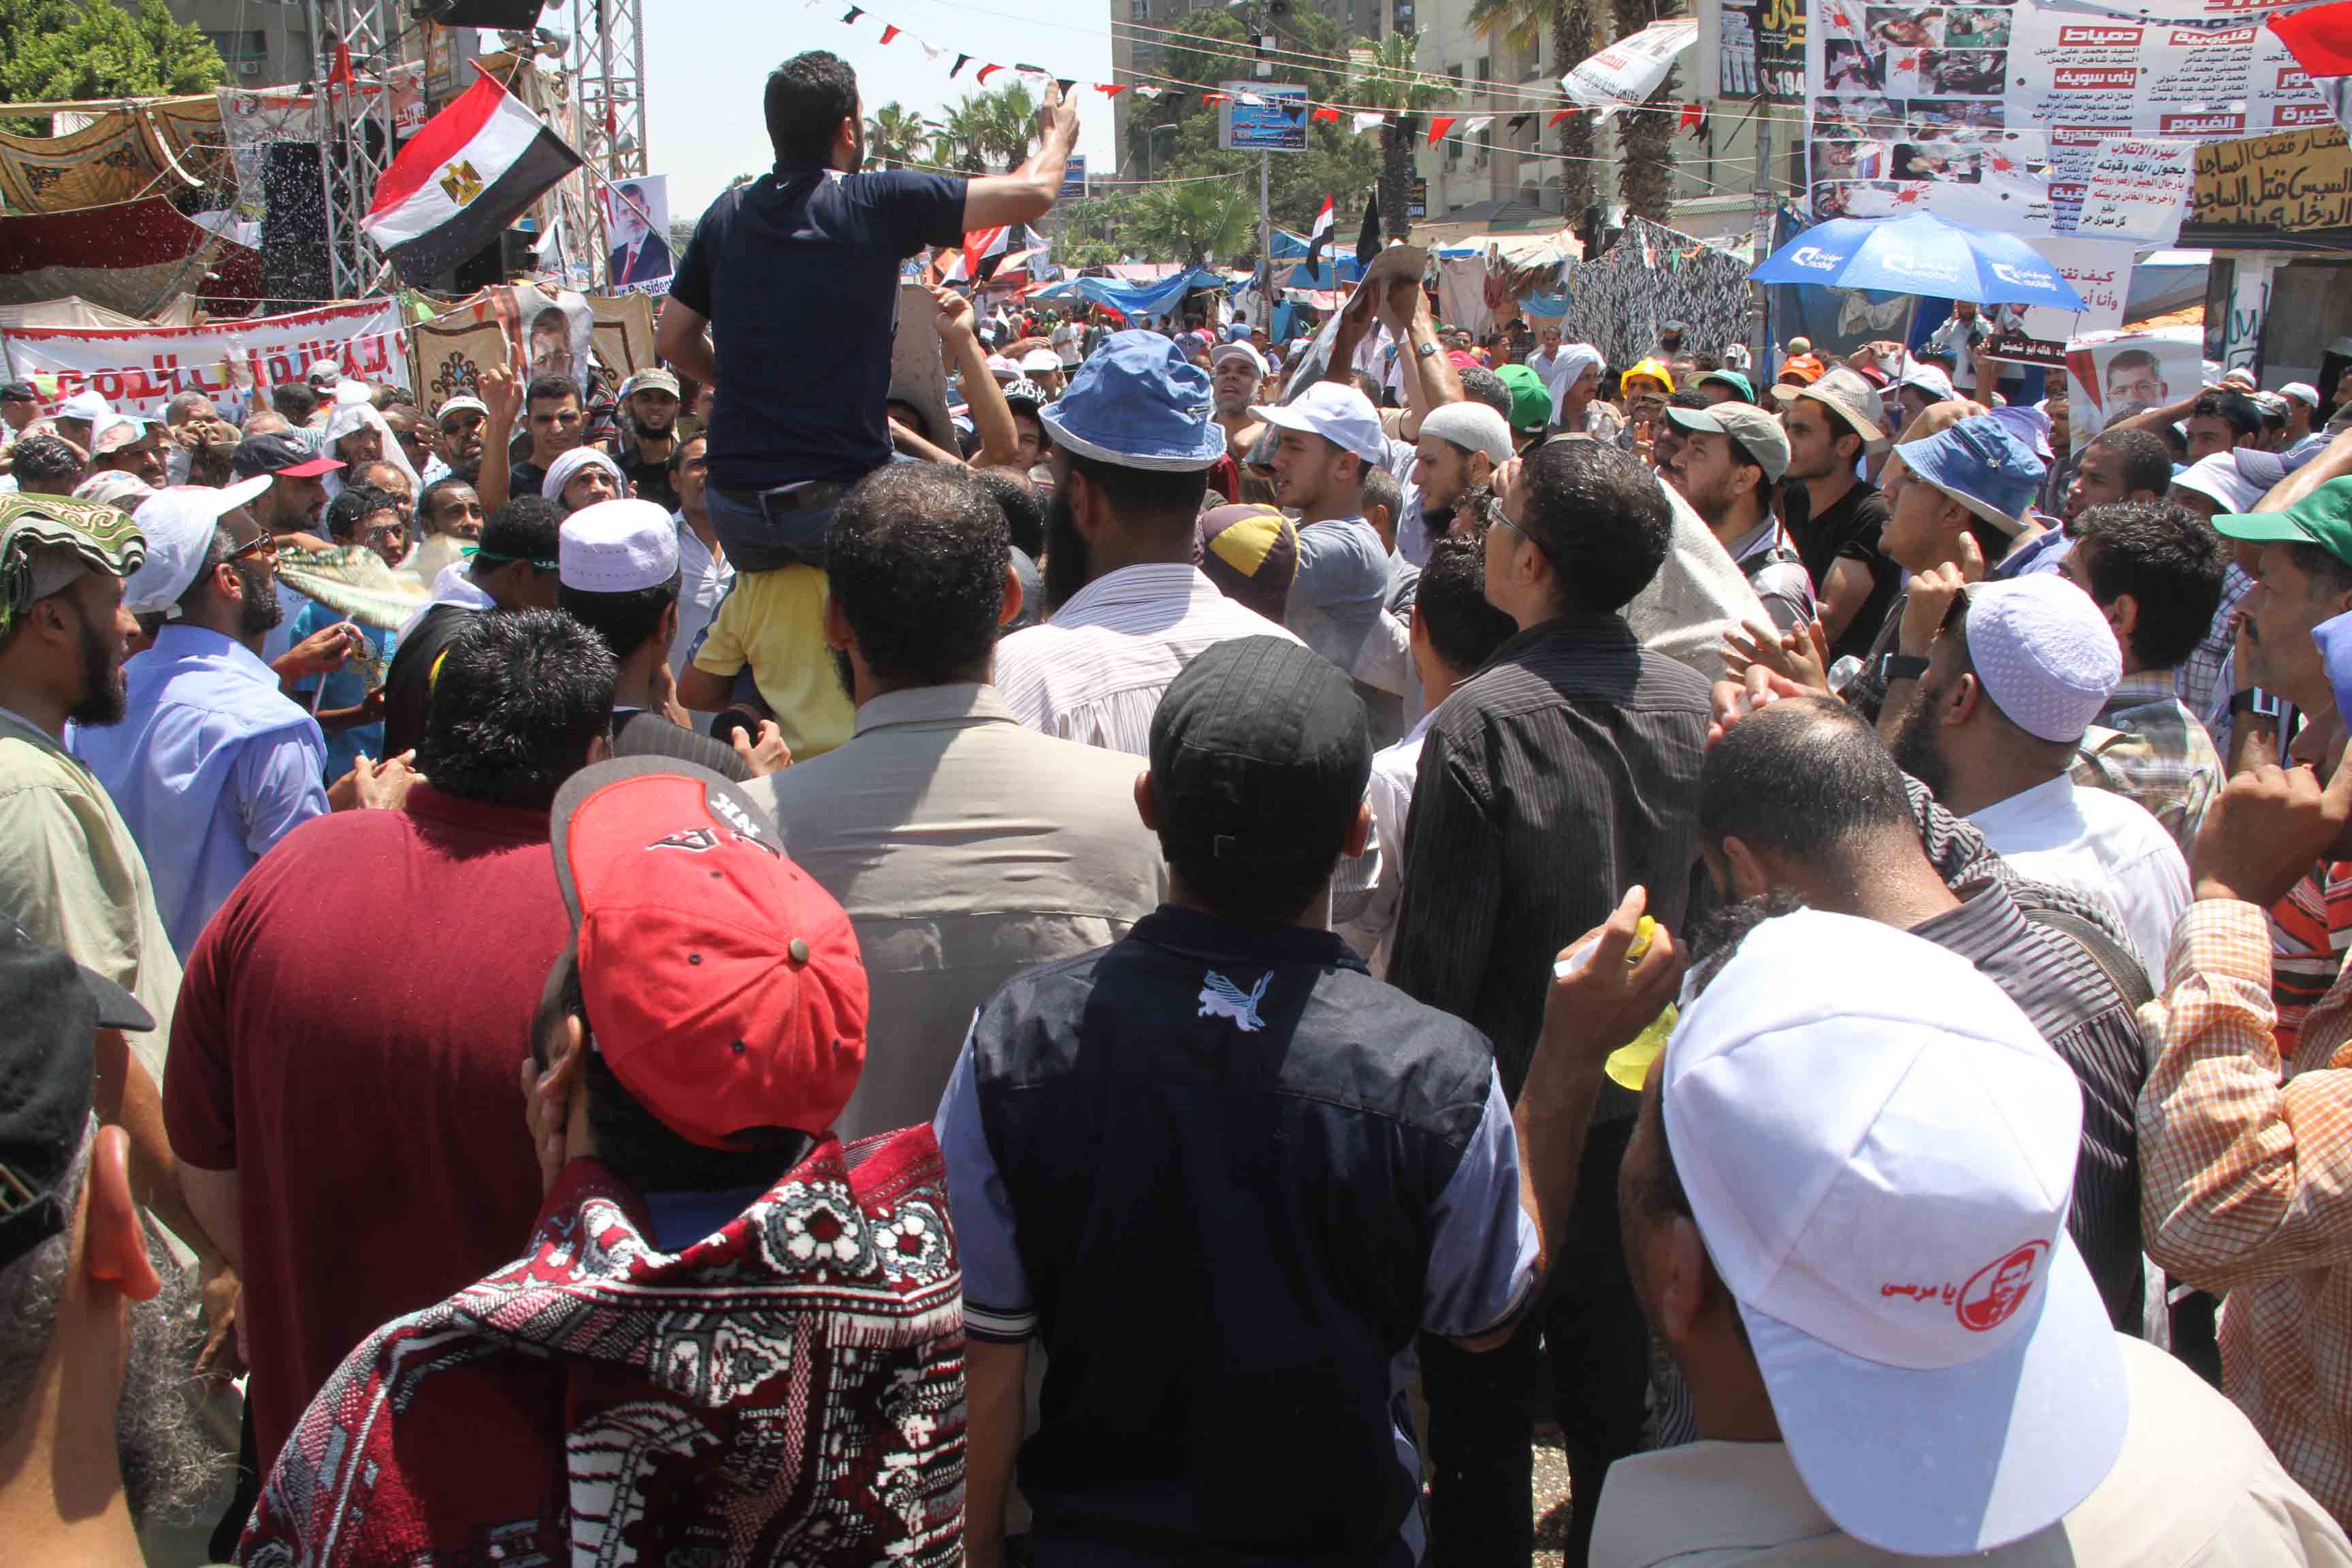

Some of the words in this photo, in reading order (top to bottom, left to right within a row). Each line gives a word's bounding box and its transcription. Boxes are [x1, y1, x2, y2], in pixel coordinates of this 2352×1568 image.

[2063, 29, 2139, 44] دمياط
[2174, 29, 2253, 45] قليوبية
[2109, 56, 2138, 65] السيد
[2204, 56, 2228, 64] السيد
[2056, 70, 2104, 86] سويف
[2196, 84, 2219, 93] السيد
[2170, 116, 2236, 133] الفيوم
[2151, 165, 2186, 178] بحول
[2081, 270, 2114, 286] كيف
[2095, 290, 2119, 311] وأنا
[1942, 1282, 1957, 1306] يا
